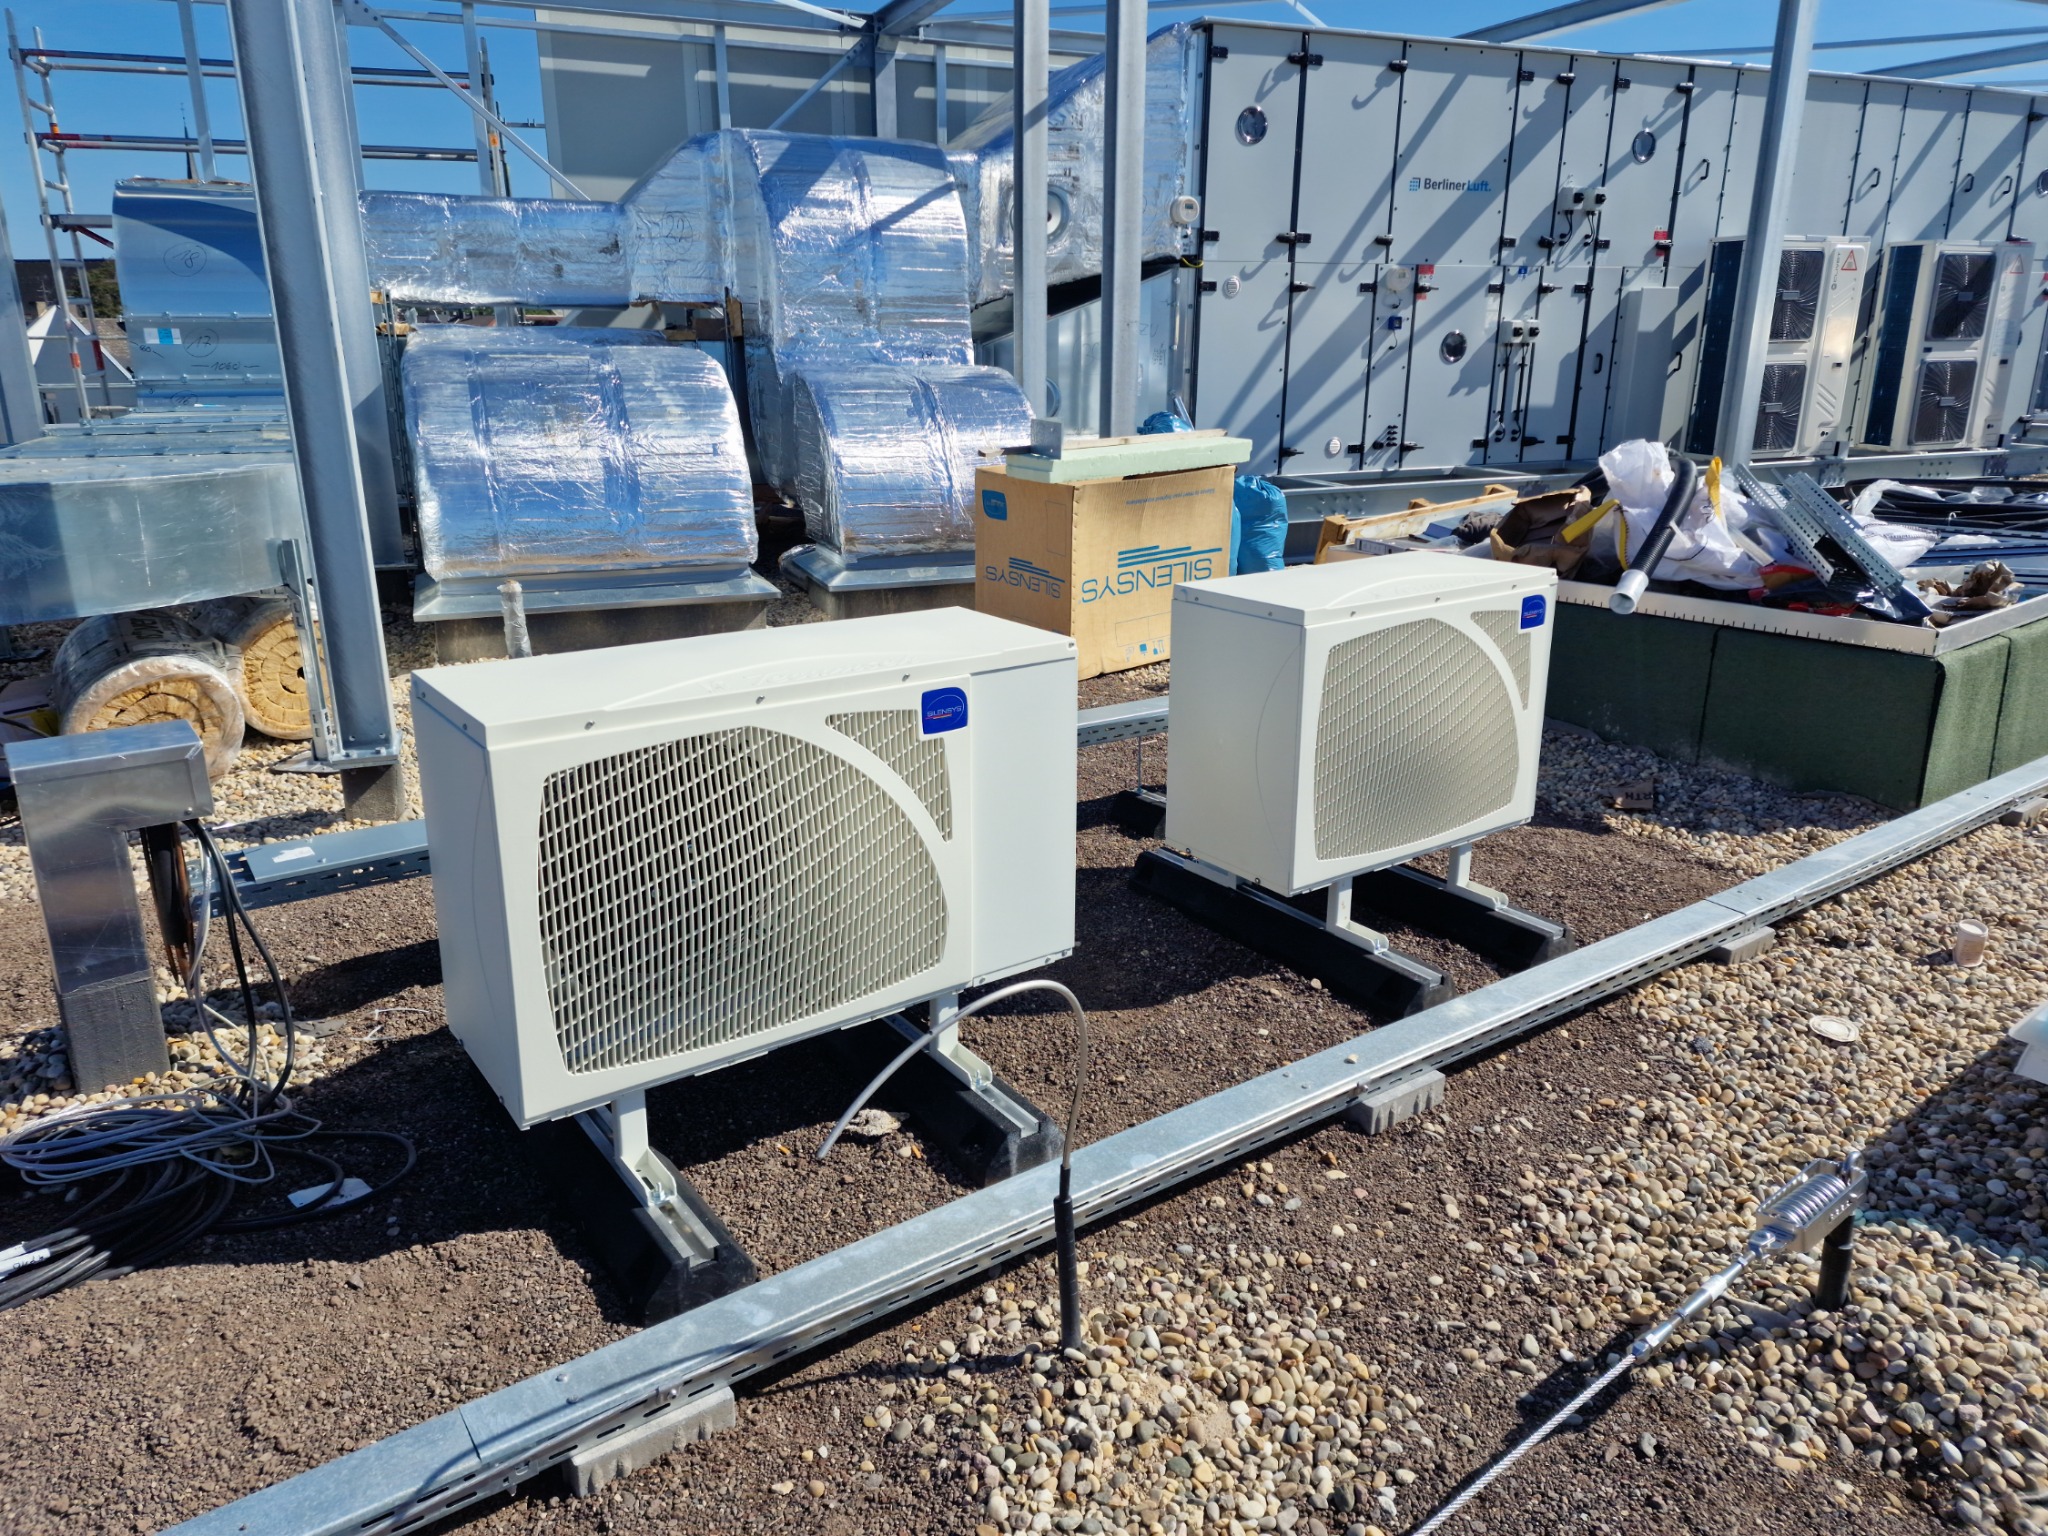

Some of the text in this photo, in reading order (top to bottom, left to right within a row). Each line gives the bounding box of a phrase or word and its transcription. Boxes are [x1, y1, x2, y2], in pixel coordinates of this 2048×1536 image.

[1424, 178, 1492, 192] BerlinerLuft.
[985, 565, 1061, 599] SILENSYS
[1081, 558, 1213, 604] SILENSYS
